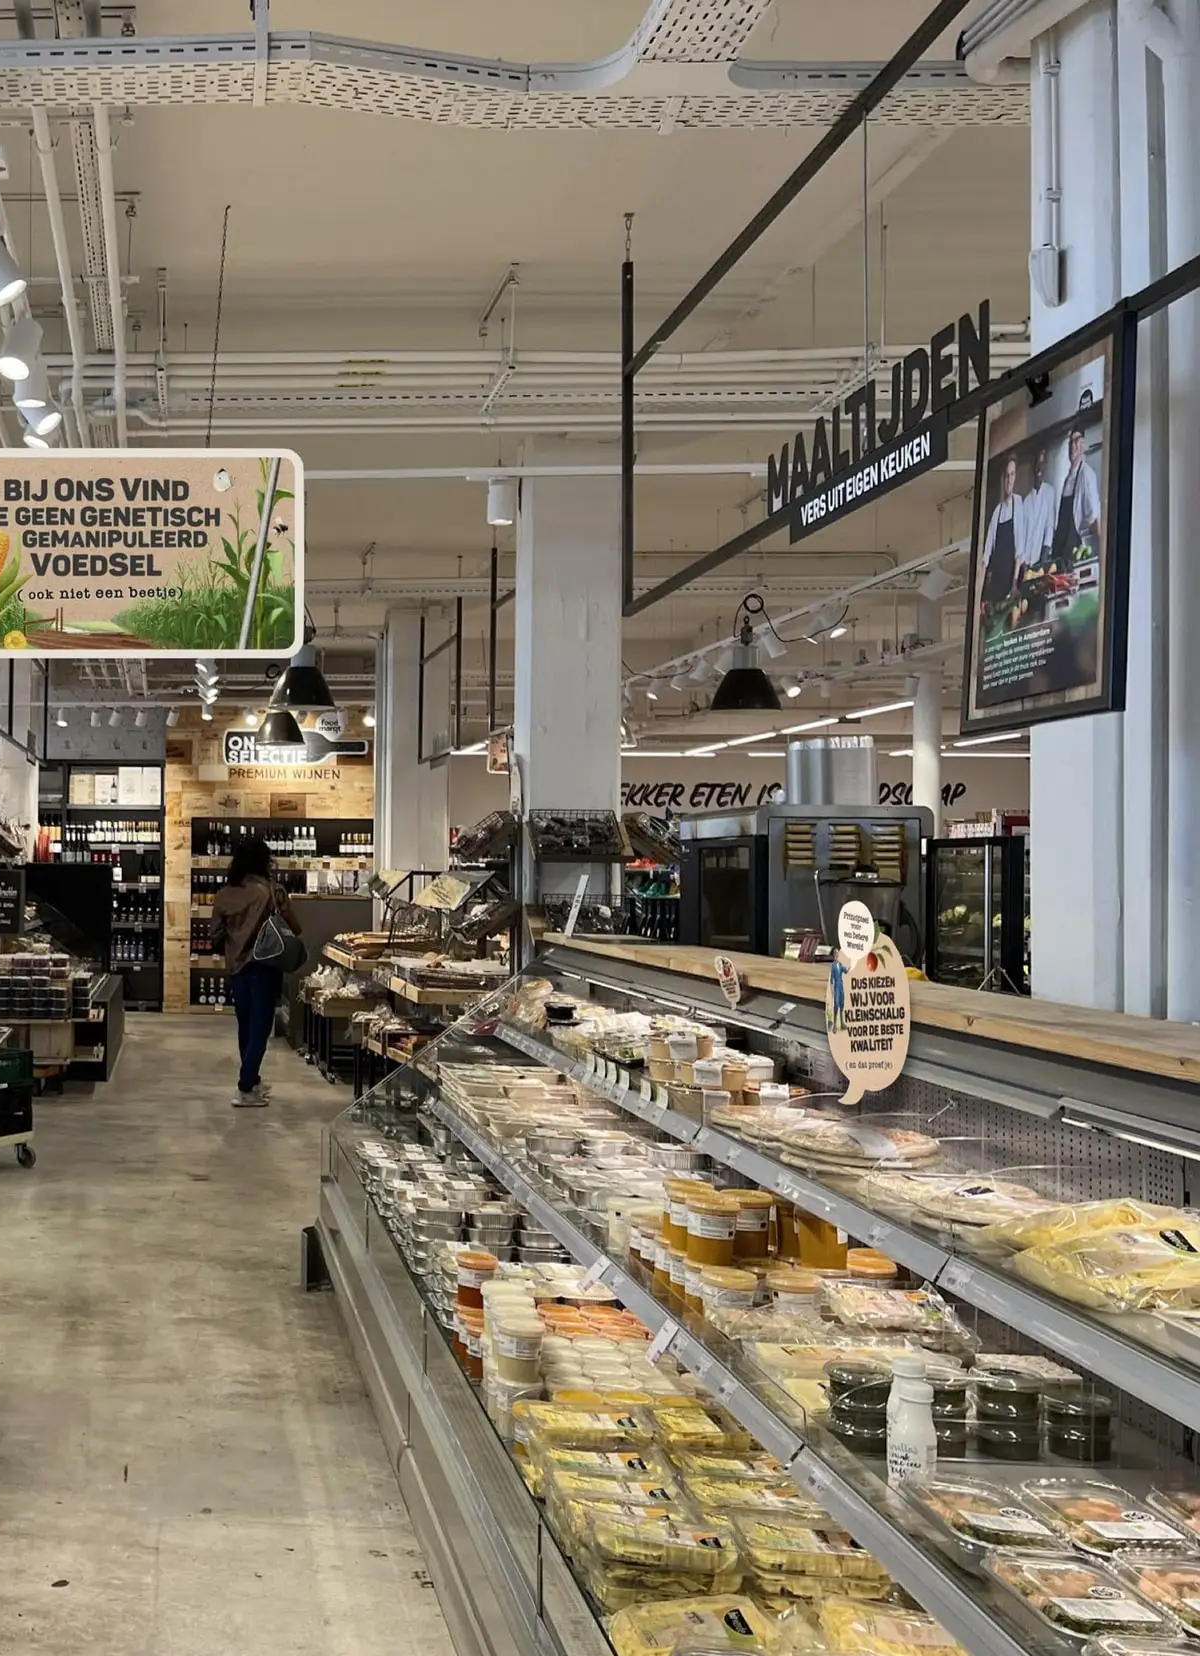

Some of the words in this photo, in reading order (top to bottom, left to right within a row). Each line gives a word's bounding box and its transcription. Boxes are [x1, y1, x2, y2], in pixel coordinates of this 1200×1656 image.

[768, 298, 990, 517] MAALTIJDEN
[800, 494, 826, 527] VERS
[828, 482, 845, 512] UIT
[846, 462, 878, 502] EIGEN
[880, 431, 930, 482] KEUKEN
[4, 478, 48, 501] BIJ
[54, 477, 115, 502] ONS
[120, 477, 190, 501] VIND
[14, 507, 75, 526] GEEN
[80, 506, 221, 527] GENETISCH
[22, 530, 208, 548] GEMANIPULEERD
[30, 552, 162, 577] VOEDSEL
[28, 589, 54, 599] ook
[59, 588, 91, 599] niet
[95, 589, 124, 599] een
[228, 750, 308, 764] SELECTIE
[229, 768, 287, 779] PREMIUM
[292, 768, 341, 779] WIJNEN
[619, 783, 685, 807] EKKER
[689, 783, 751, 808] ETEN
[851, 977, 867, 990] DUS
[868, 976, 895, 989] KIEZEN
[850, 992, 868, 1007] WIJ
[869, 991, 895, 1006] VOOR
[845, 1007, 905, 1023] KLEINSCHALIG
[847, 1025, 868, 1037] VOOR
[869, 1025, 879, 1036] DE
[880, 1023, 904, 1035] BESTE
[850, 1038, 893, 1052] KWALITEIT
